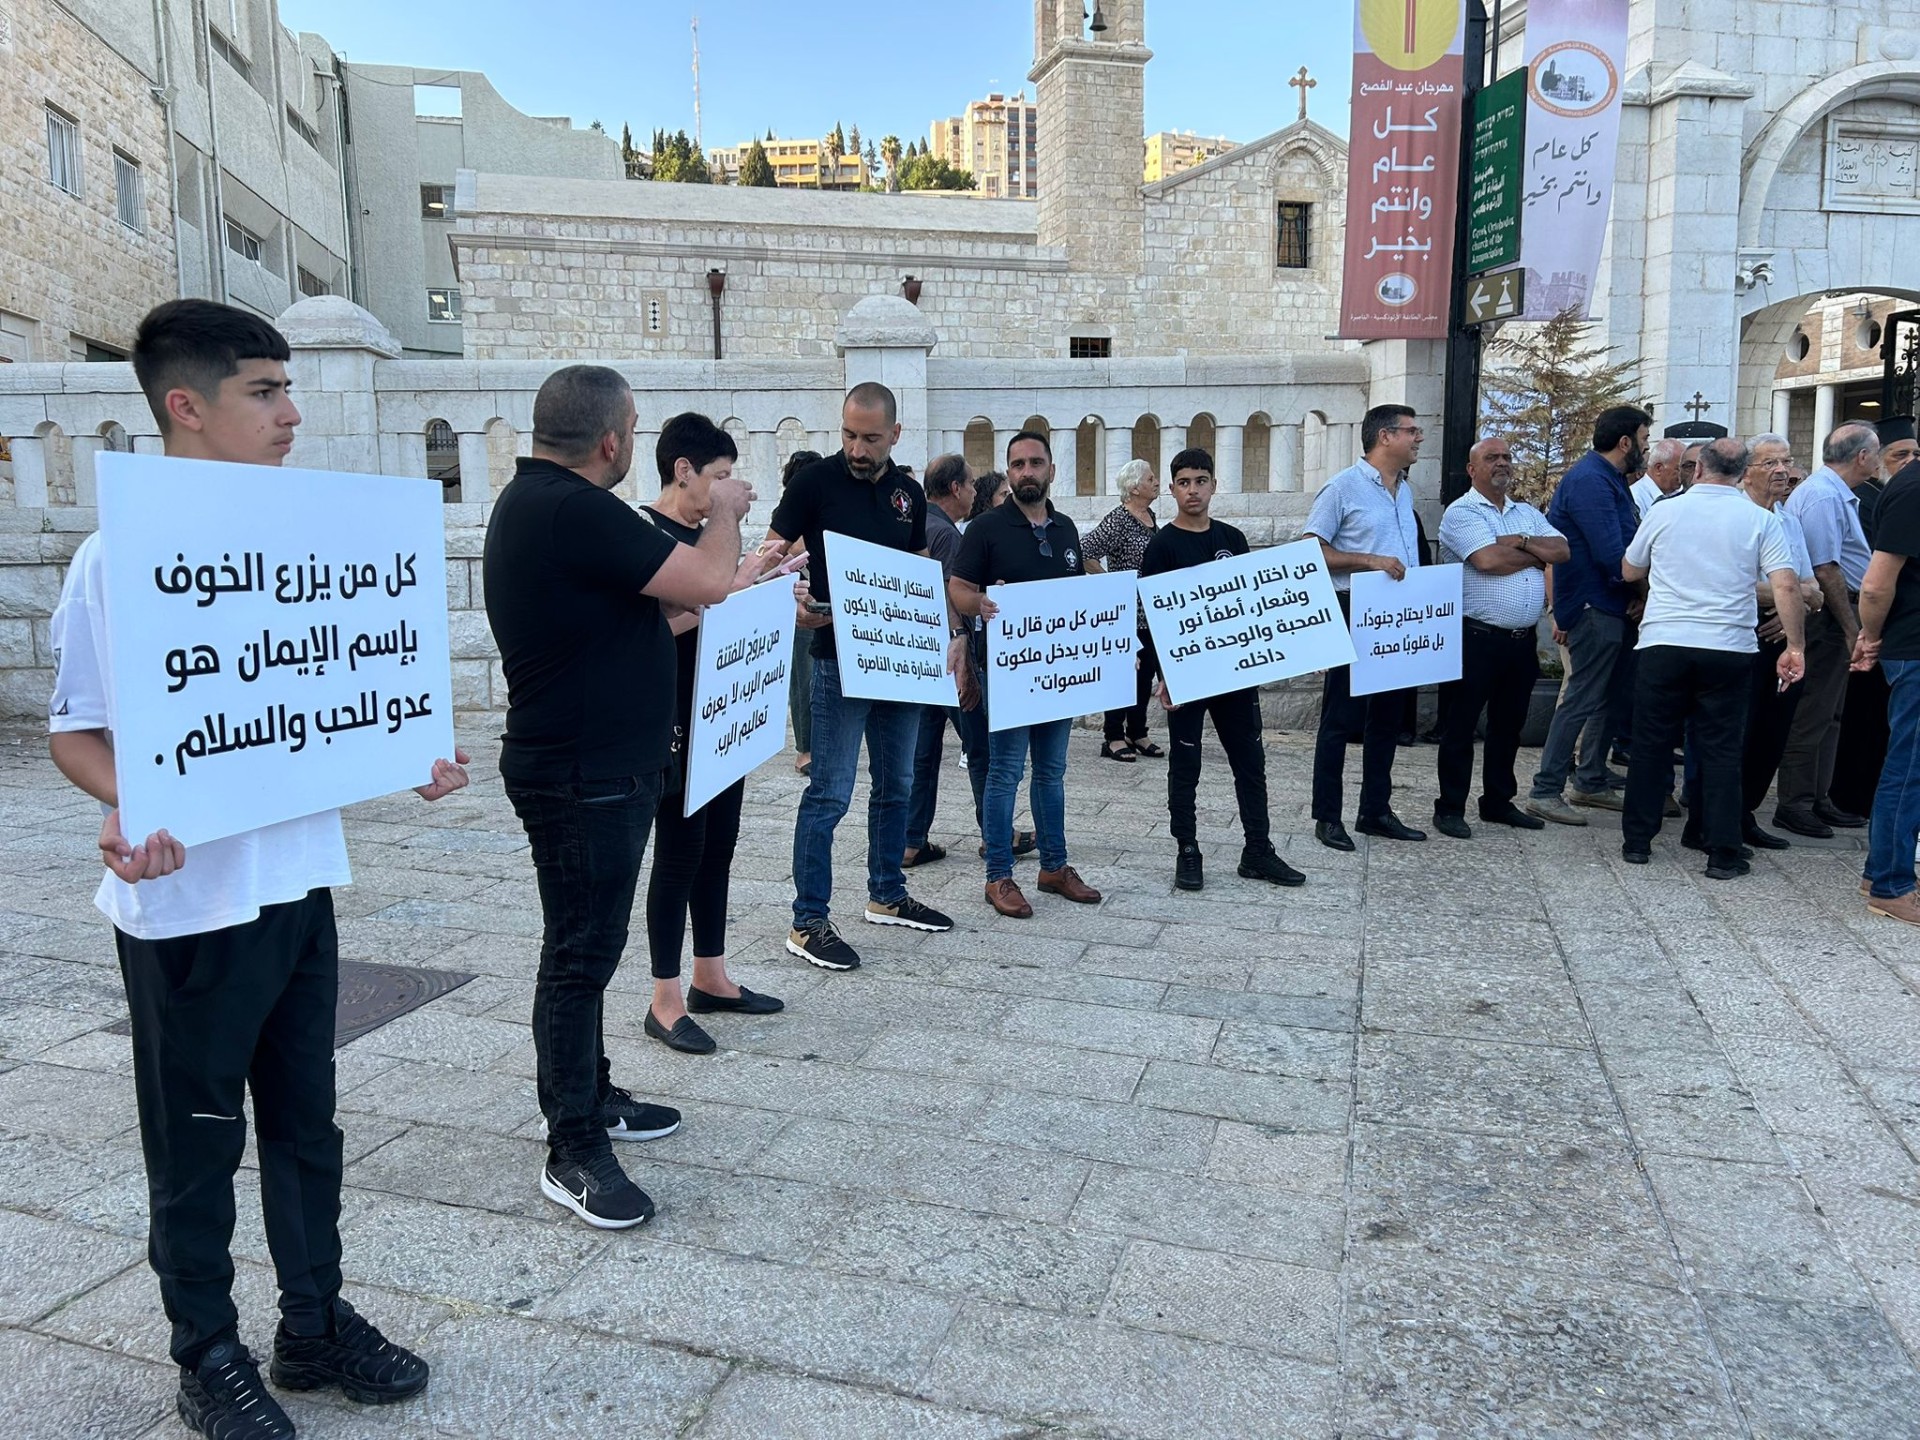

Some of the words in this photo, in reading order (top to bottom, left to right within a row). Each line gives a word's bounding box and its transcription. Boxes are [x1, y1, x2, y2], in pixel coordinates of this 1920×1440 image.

[1360, 80, 1392, 96] الفصح
[1395, 82, 1413, 95] عيد
[1415, 80, 1454, 96] مهرجان
[1373, 106, 1440, 139] كل
[1533, 136, 1567, 170] عام
[1571, 131, 1599, 161] كل
[1373, 146, 1435, 184] عام
[1558, 170, 1602, 214] وانتم
[1372, 186, 1432, 224] وانتم
[1364, 226, 1432, 260] بخير
[154, 552, 264, 608] الخوف
[274, 553, 331, 604] يزرع
[339, 562, 378, 600] من
[386, 552, 416, 598] كل
[845, 568, 867, 585] على
[869, 572, 901, 593] الاعتداء
[1252, 564, 1288, 591] اختار
[1293, 562, 1318, 580] من
[904, 579, 934, 600] استنكار
[1190, 574, 1248, 602] السواد
[844, 596, 868, 618] يكون
[869, 598, 877, 615] لا
[879, 602, 912, 622] دمشق،
[1153, 590, 1186, 612] راية
[1204, 596, 1245, 624] أطفأ
[1250, 588, 1310, 618] وشعار،
[1426, 604, 1433, 619] لا
[1435, 602, 1454, 618] الله
[914, 608, 942, 630] كنيسة
[1017, 616, 1042, 638] قال
[1046, 617, 1066, 635] من
[1069, 609, 1087, 632] كل
[1090, 604, 1126, 628] "ليس
[1178, 610, 1204, 636] نور
[1276, 608, 1332, 636] المحبة
[1395, 607, 1424, 628] يحتاج
[766, 629, 780, 653] من
[852, 624, 884, 646] كنيسة
[886, 631, 906, 647] على
[1002, 620, 1013, 640] يا
[1204, 624, 1274, 652] والوحدة
[238, 624, 339, 682] الإيمان
[348, 620, 418, 671] بإسم
[907, 634, 940, 656] بالاعتداء
[1046, 643, 1078, 664] يدخل
[1082, 642, 1098, 659] رب
[1102, 636, 1112, 656] يا
[1114, 636, 1130, 654] رب
[1169, 640, 1202, 663] في
[1370, 642, 1400, 659] محبة.
[1402, 634, 1430, 656] قلوبًا
[1432, 632, 1444, 652] بل
[716, 638, 746, 671] للفتنة
[857, 653, 891, 674] الناصرة
[996, 646, 1042, 671] ملكوت
[1234, 648, 1286, 672] داخله.
[165, 644, 220, 693] هو
[762, 660, 785, 695] باسم
[892, 660, 910, 678] في
[911, 660, 942, 682] البشارة
[731, 681, 738, 704] لا
[740, 670, 761, 703] الرب،
[316, 690, 378, 745] للحب
[387, 692, 433, 734] عدو
[702, 694, 728, 724] يعرف
[738, 704, 768, 746] تعاليم
[714, 722, 738, 758] الرب.
